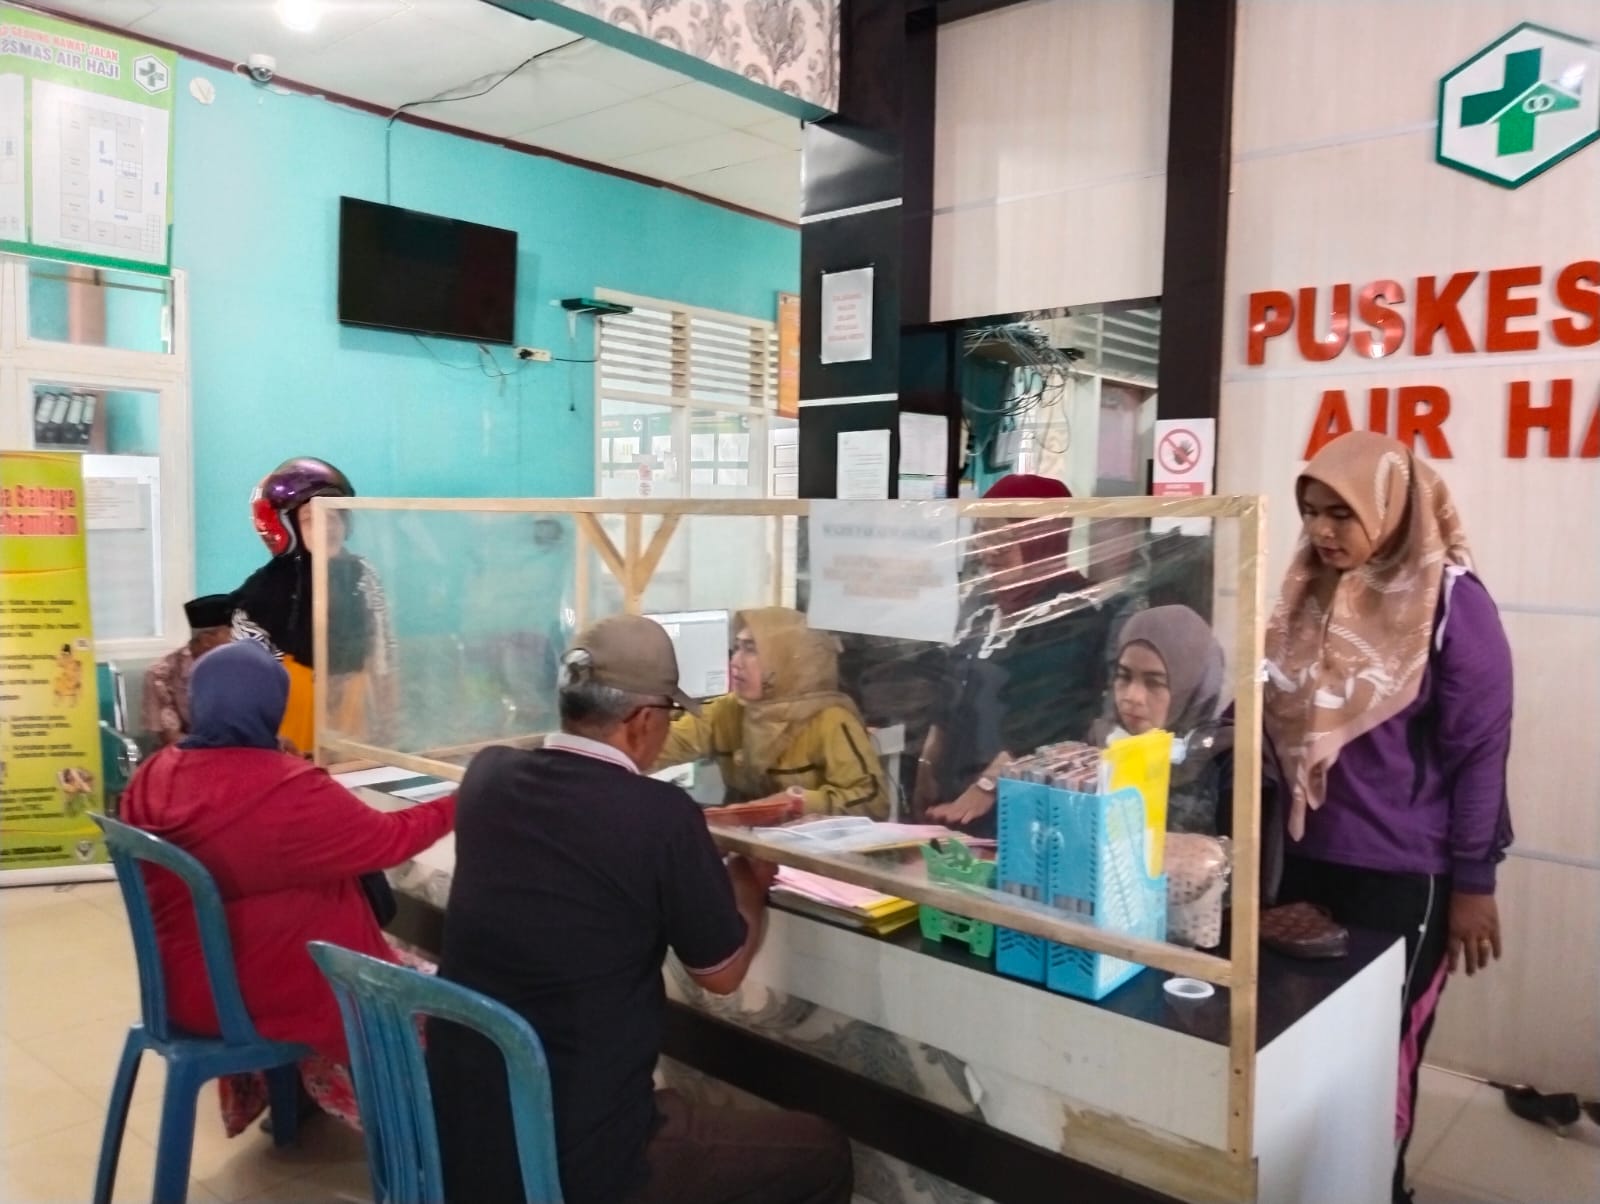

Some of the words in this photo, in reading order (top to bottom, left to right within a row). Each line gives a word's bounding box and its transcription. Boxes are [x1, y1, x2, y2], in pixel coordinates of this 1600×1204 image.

[57, 51, 82, 69] AIR
[87, 58, 119, 78] HAJI
[89, 46, 118, 61] JALAN
[1301, 385, 1453, 462] AIR
